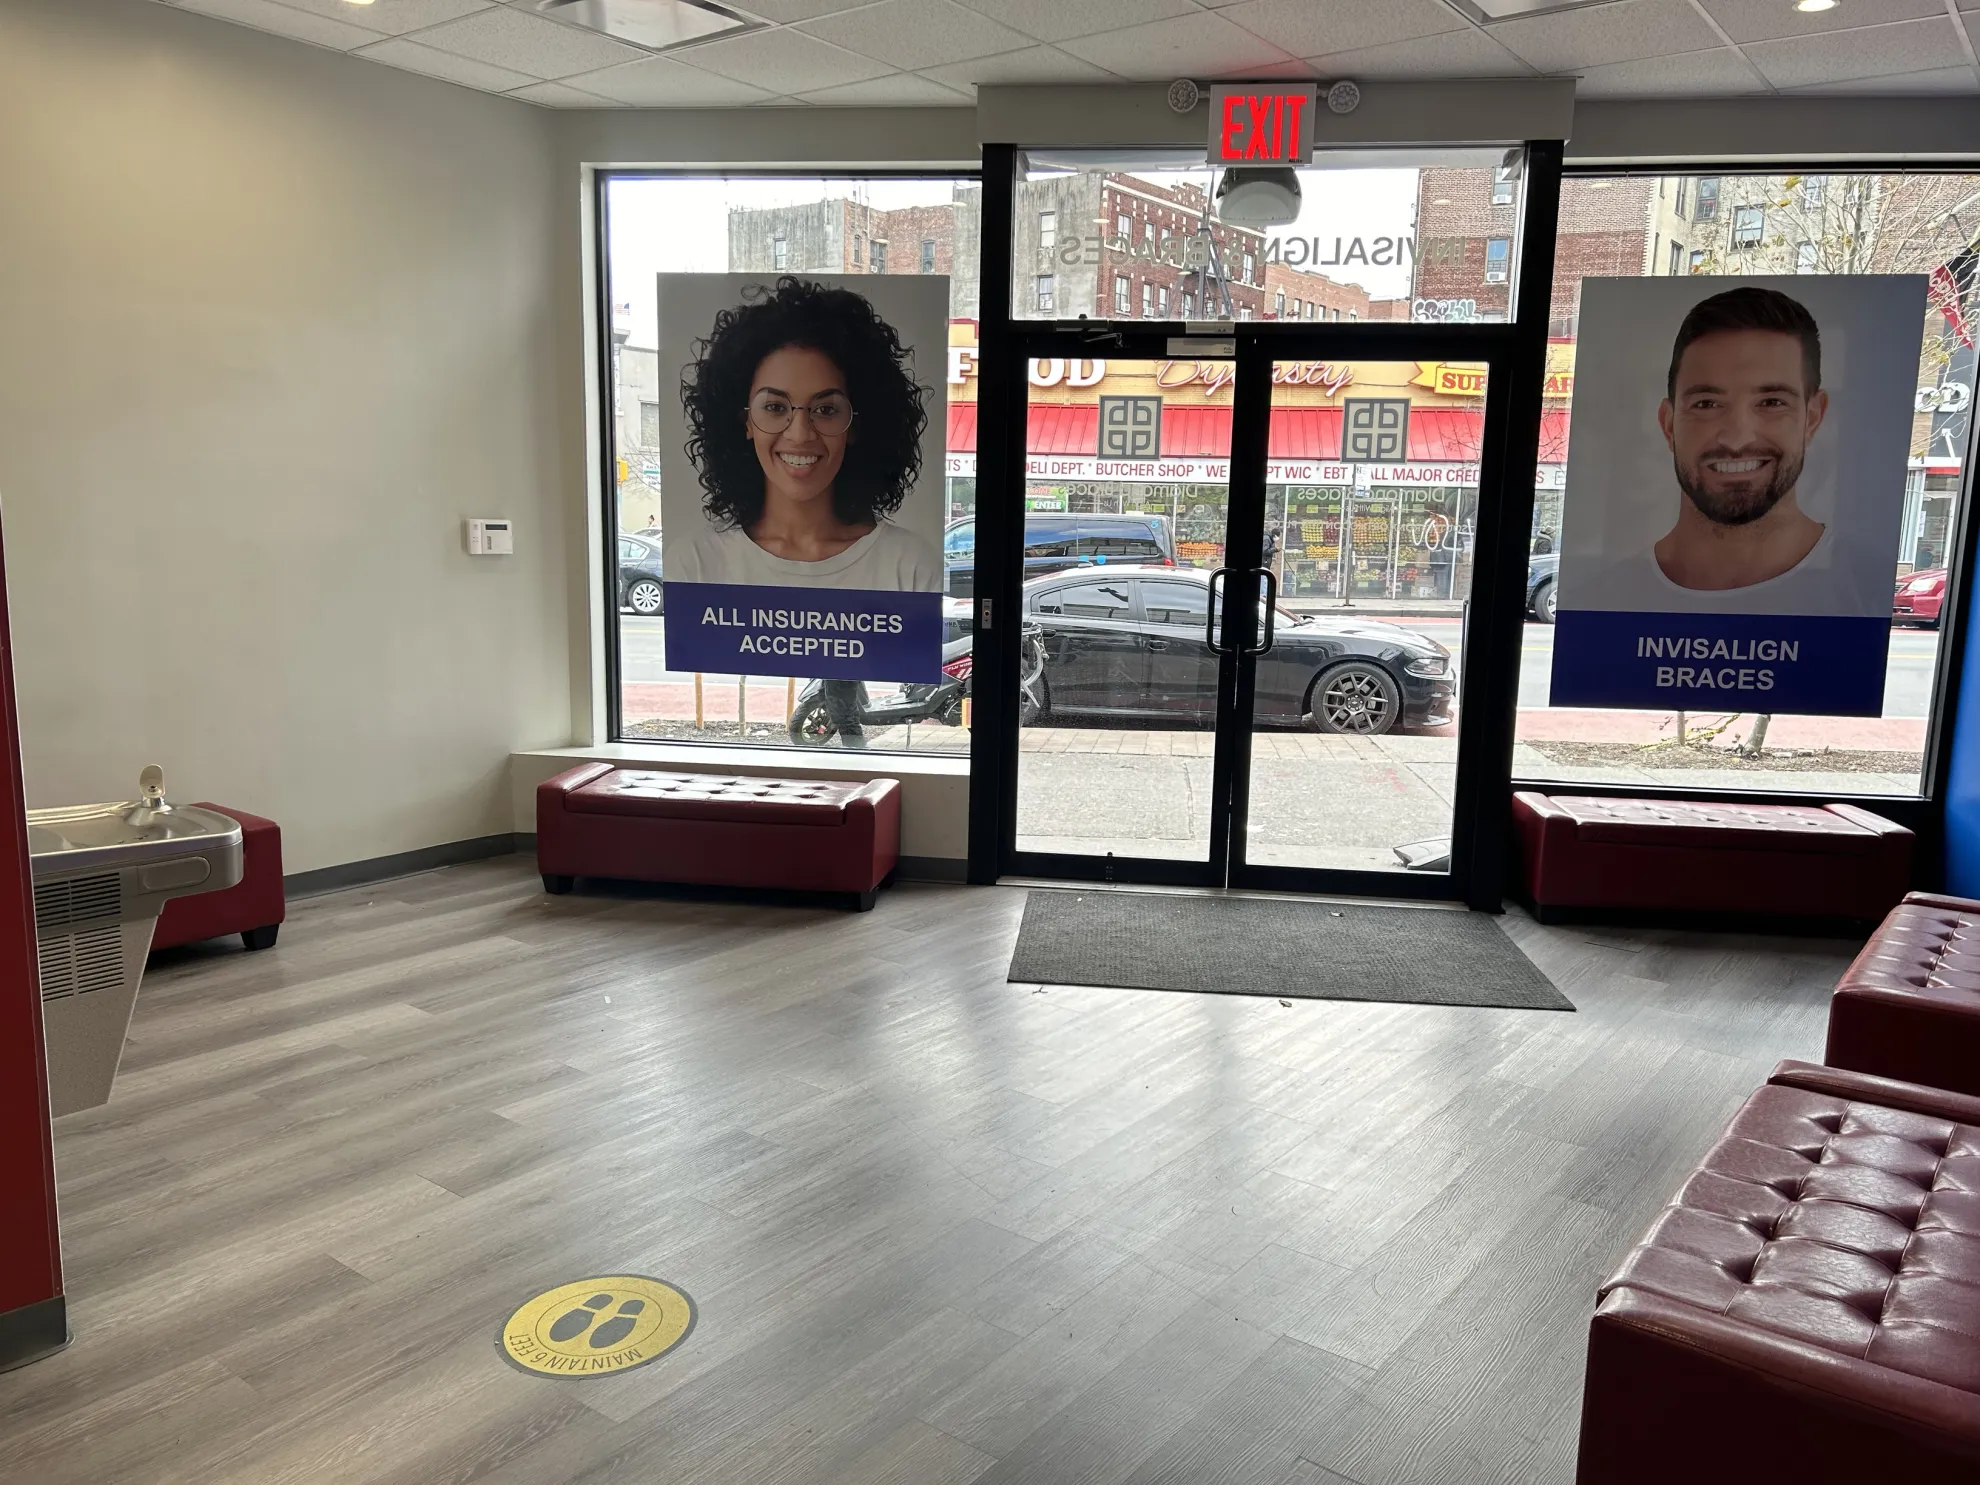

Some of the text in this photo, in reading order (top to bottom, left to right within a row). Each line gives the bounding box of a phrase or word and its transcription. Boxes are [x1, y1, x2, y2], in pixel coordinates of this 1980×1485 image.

[1222, 95, 1307, 159] EXIT
[1052, 462, 1085, 475] DEPT.
[1096, 463, 1154, 477] BUTCHER
[1158, 464, 1194, 477] SHOP
[1206, 465, 1227, 478] WE
[1285, 466, 1312, 479] WIC
[1324, 466, 1349, 480] EBT
[1393, 468, 1442, 482] MAJOR
[1447, 469, 1479, 482] CRED
[701, 606, 903, 634] ALL INSURANCES
[739, 634, 865, 658] ACCEPTED
[1637, 636, 1799, 662] INVISALIGN
[1656, 666, 1775, 691] BRACES
[509, 1332, 643, 1371] MAINTAIN 6 FEET
